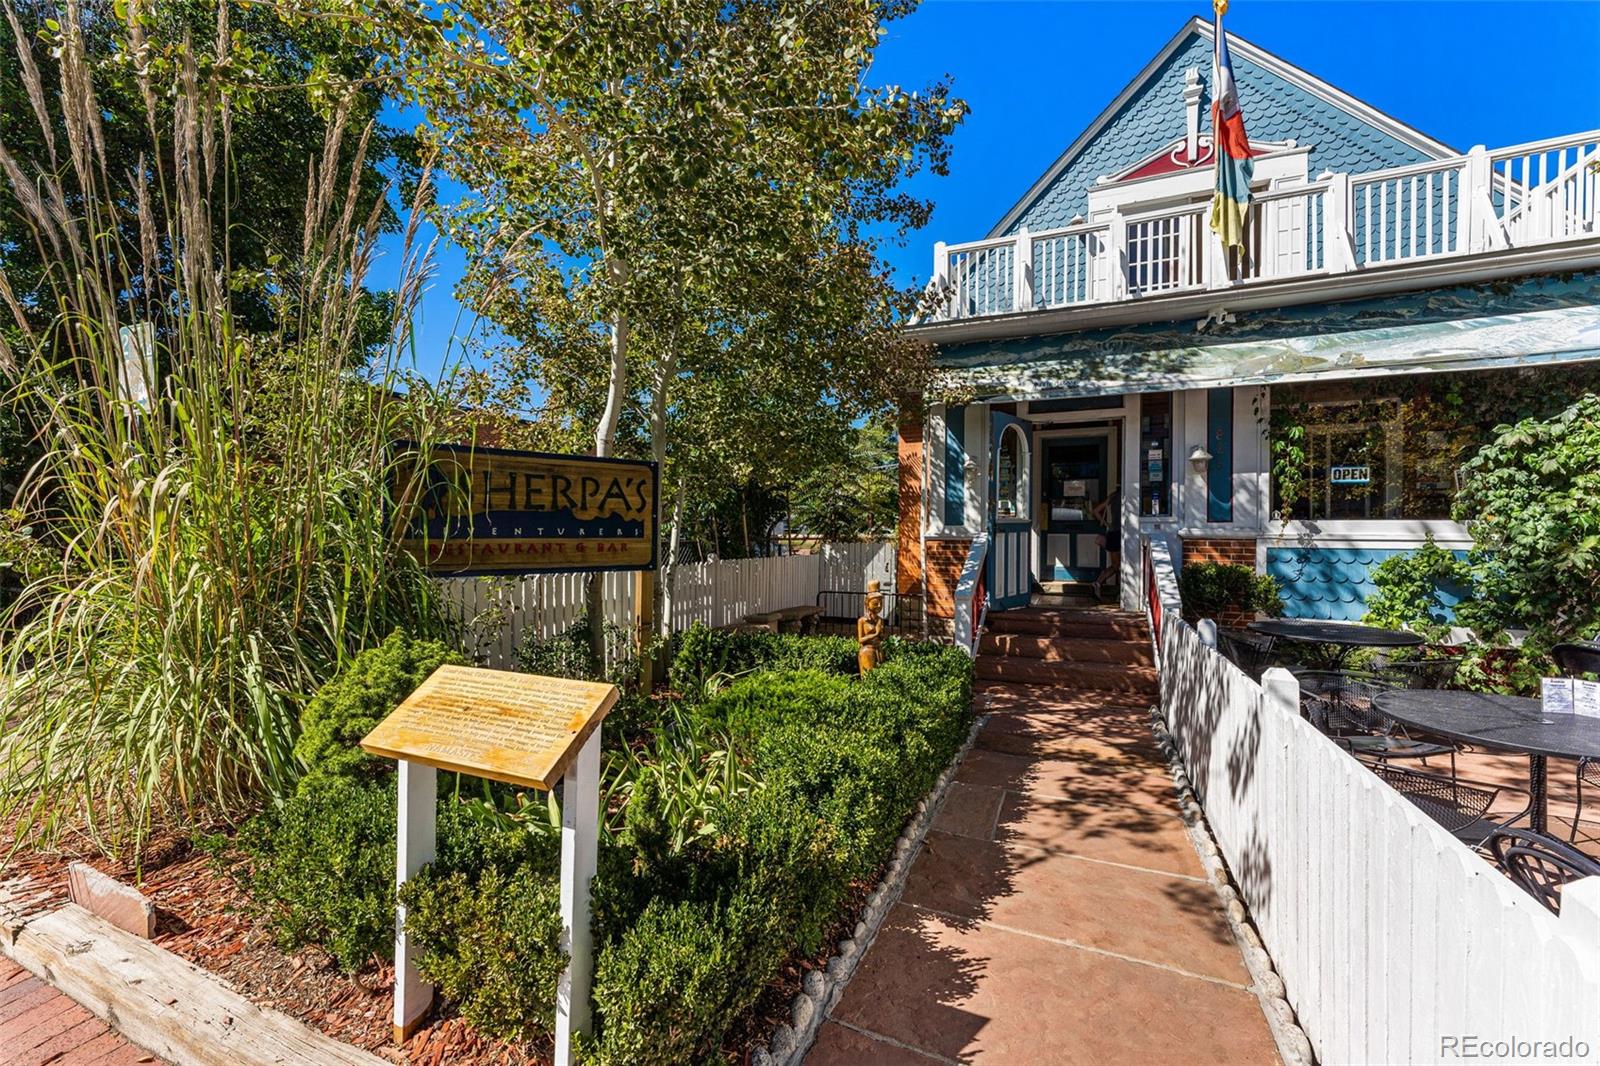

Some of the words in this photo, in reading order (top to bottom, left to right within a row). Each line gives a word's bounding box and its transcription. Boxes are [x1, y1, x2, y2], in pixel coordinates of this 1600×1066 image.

[1333, 468, 1368, 481] OPEN
[414, 527, 640, 537] AVENTURERS
[575, 542, 587, 554] &
[597, 542, 630, 554] BAR
